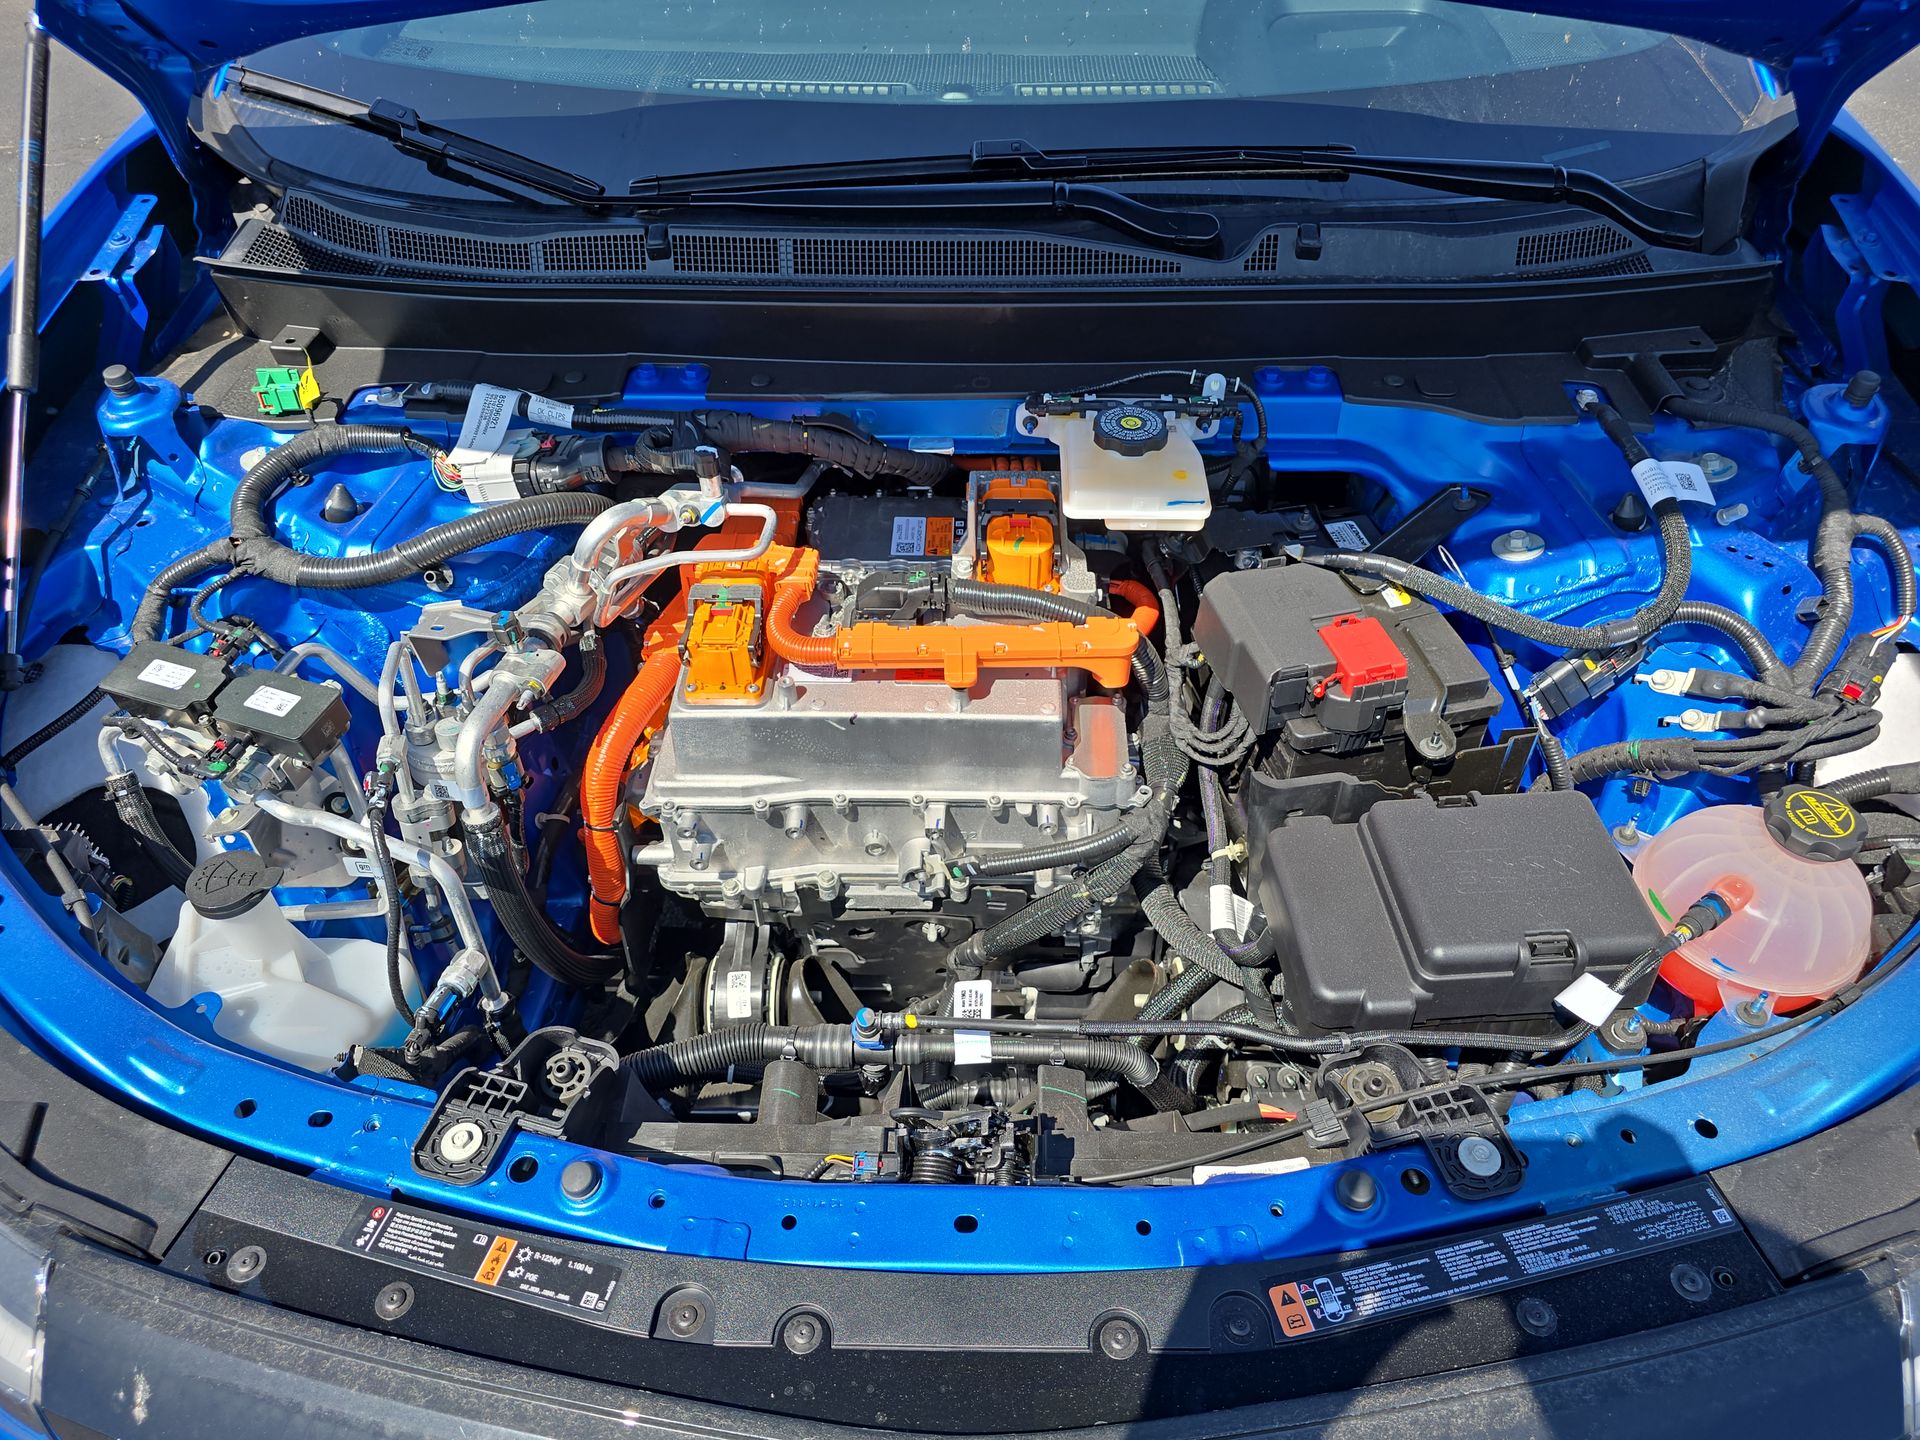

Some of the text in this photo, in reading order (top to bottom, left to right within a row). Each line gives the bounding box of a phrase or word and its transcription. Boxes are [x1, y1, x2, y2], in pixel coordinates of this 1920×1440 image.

[489, 394, 506, 429] 85096921
[534, 1252, 562, 1266] R-1234yf
[568, 1261, 594, 1274] 1.100 kg
[524, 1272, 538, 1282] POE
